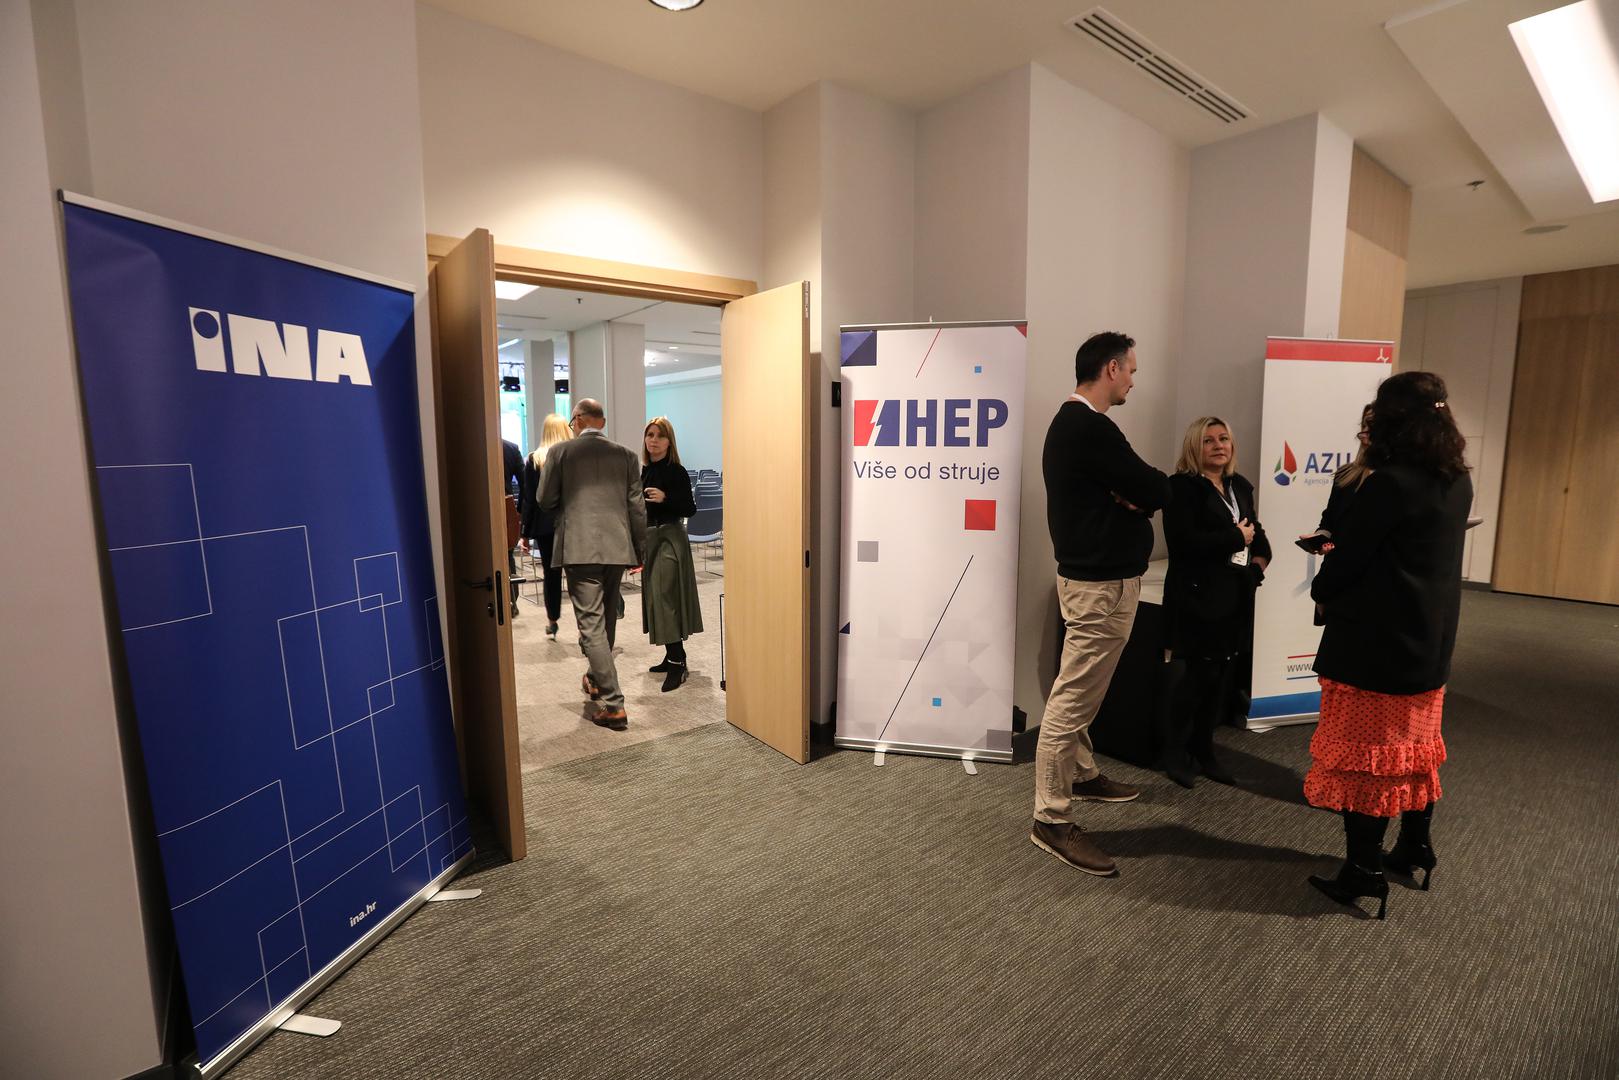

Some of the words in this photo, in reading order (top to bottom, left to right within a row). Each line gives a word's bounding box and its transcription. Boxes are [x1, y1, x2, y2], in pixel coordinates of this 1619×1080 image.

[906, 398, 1009, 447] HEP
[853, 460, 897, 479] Više
[904, 461, 931, 479] od
[939, 461, 1000, 485] struje
[349, 901, 377, 928] ina.hr
